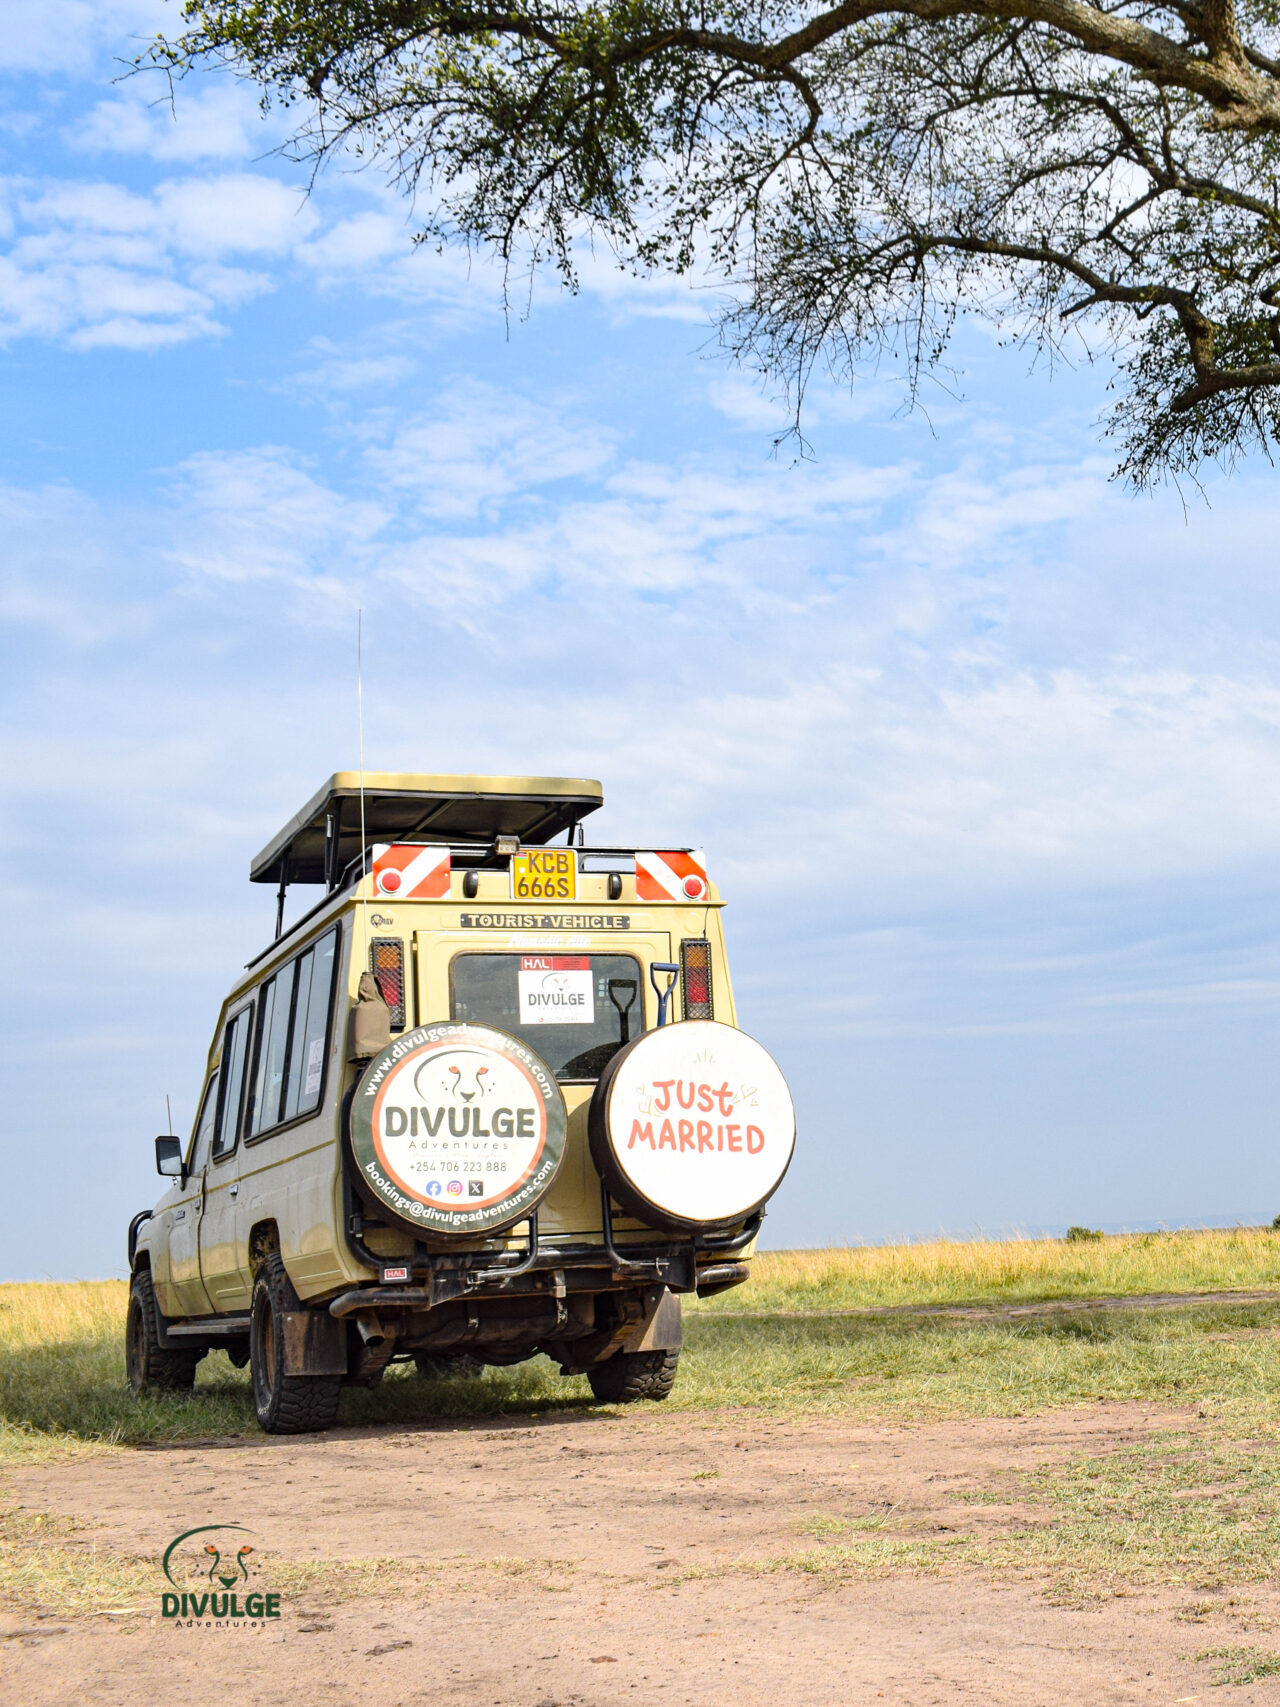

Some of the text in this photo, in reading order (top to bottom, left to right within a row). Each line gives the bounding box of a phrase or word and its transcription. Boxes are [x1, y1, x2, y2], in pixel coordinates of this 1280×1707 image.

[528, 852, 569, 873] KCB
[518, 876, 570, 897] 666S
[469, 914, 623, 929] TOURIST VEHICLE
[523, 958, 550, 969] HAL
[528, 993, 585, 1006] DIVULGE
[385, 1106, 536, 1138] DIVULGE
[627, 1118, 766, 1155] MARRIED
[408, 1140, 509, 1150] Adventures
[409, 1161, 507, 1172] +254 706 223 888
[365, 1159, 554, 1225] bookings@divulgeadventures.com
[387, 1270, 404, 1278] HAL
